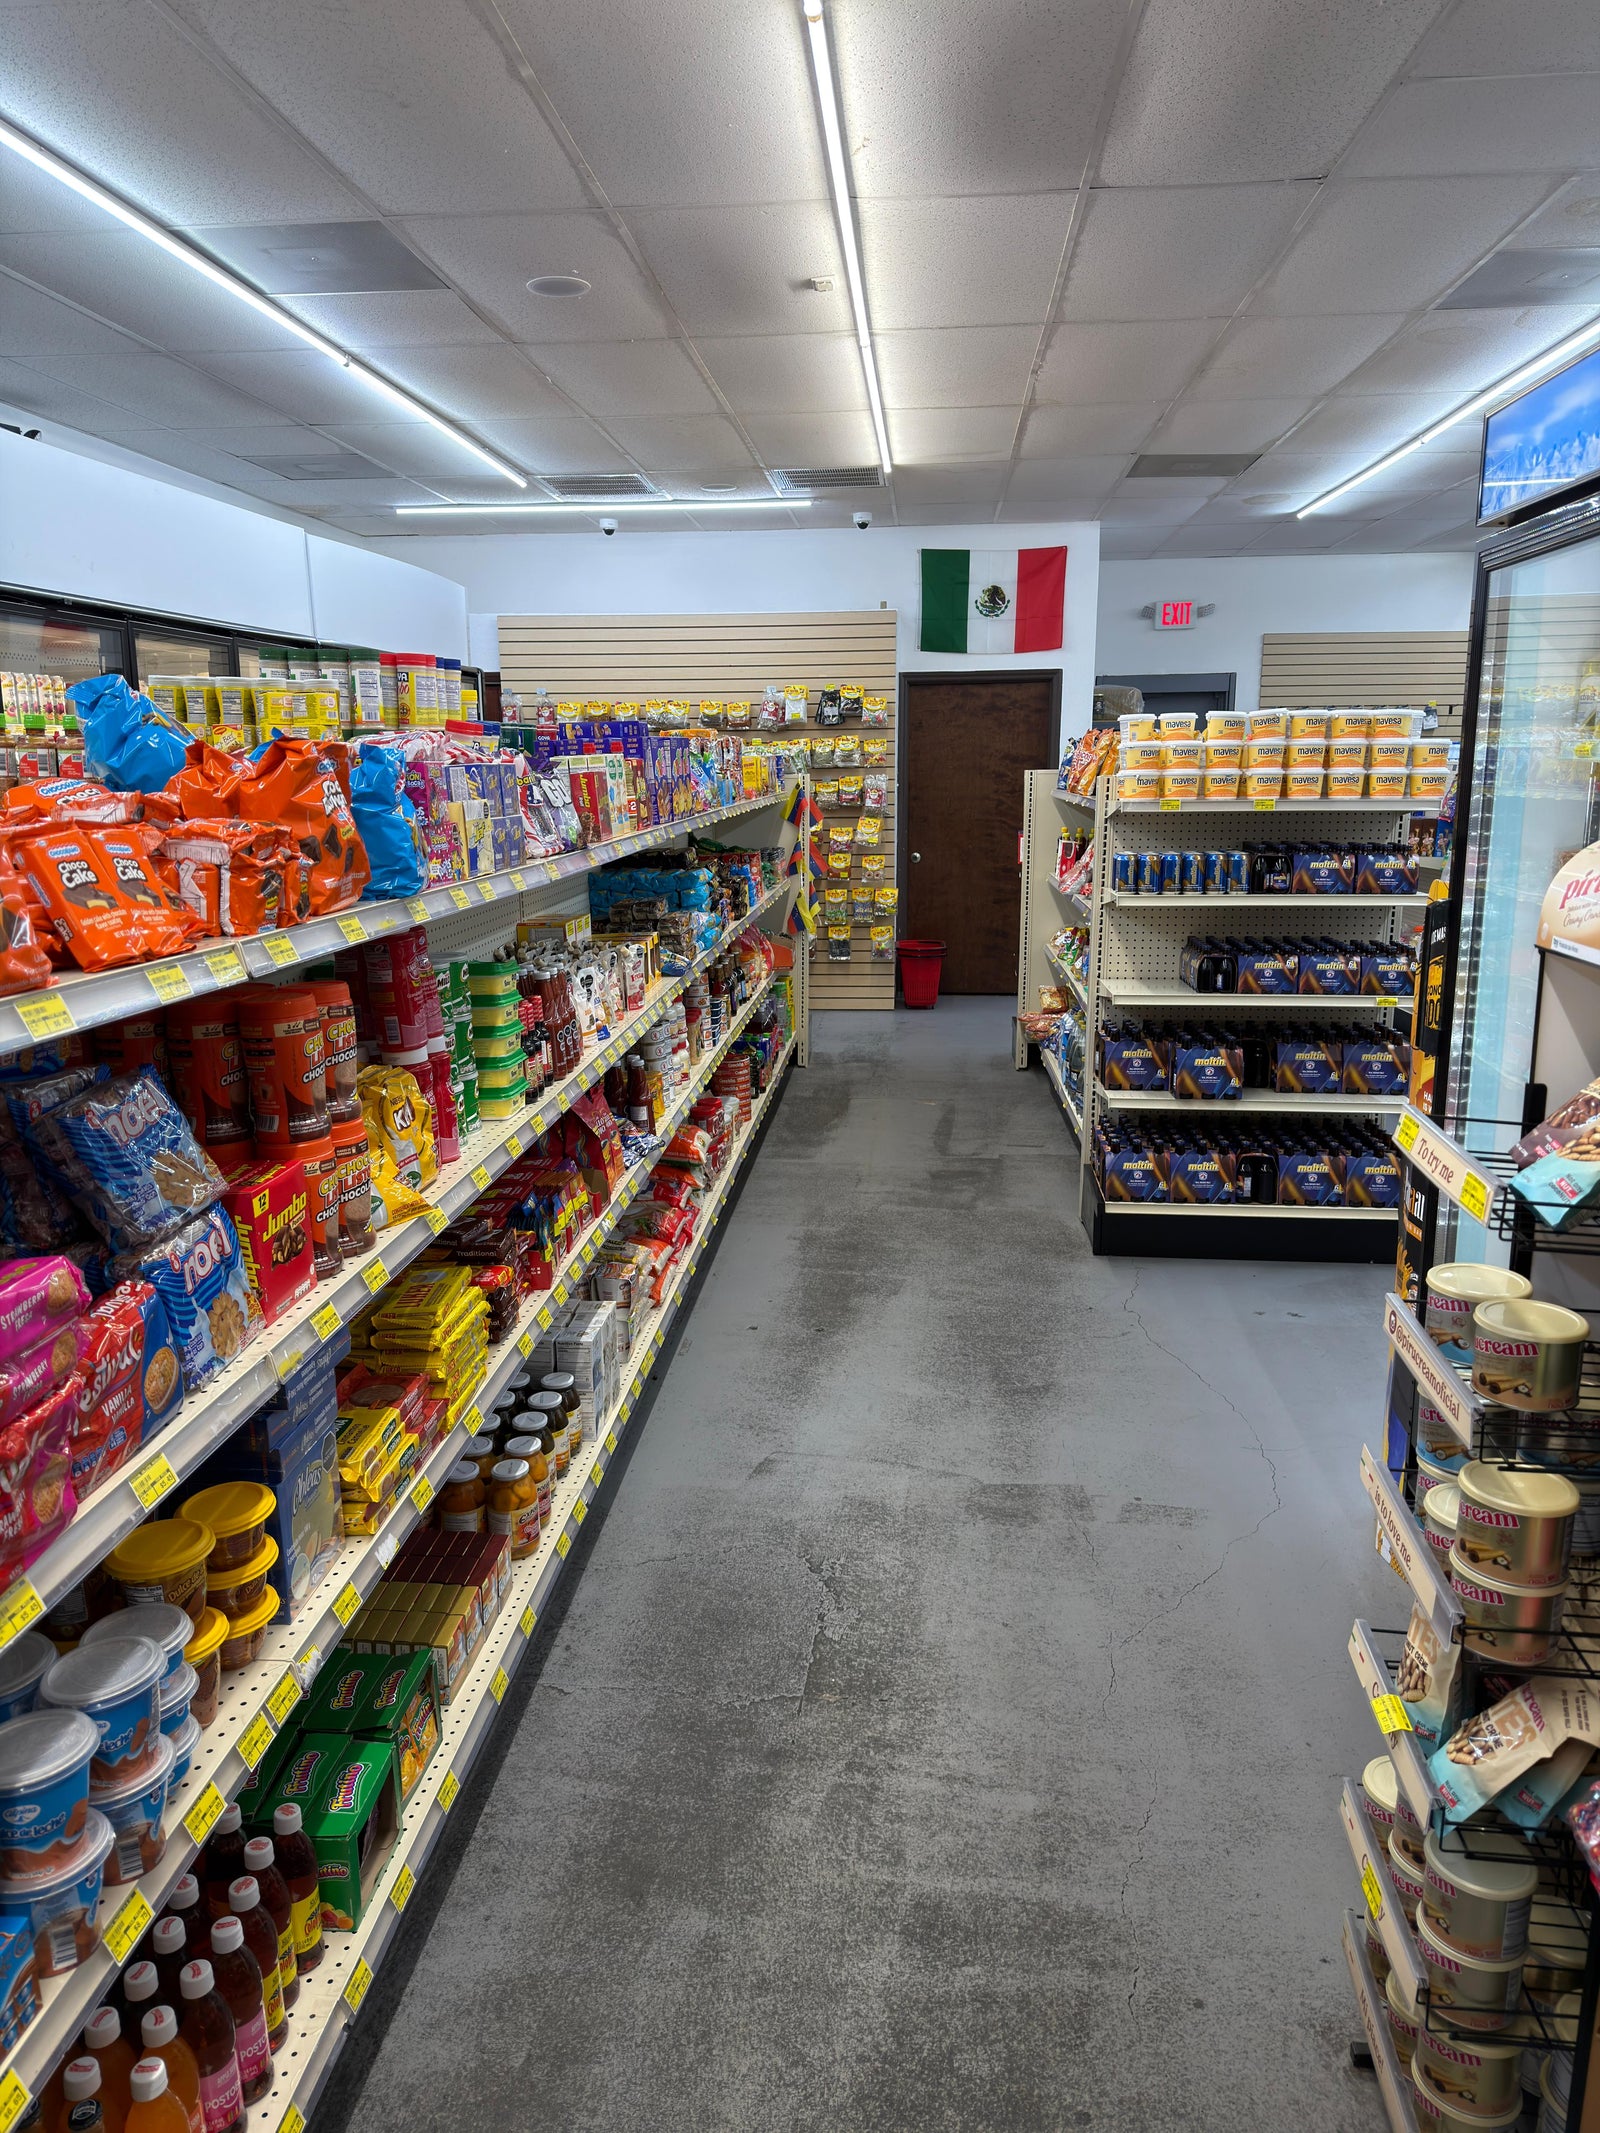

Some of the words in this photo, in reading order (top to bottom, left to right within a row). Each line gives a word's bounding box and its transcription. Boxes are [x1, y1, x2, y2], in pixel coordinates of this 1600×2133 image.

[1162, 602, 1192, 625] EXIT
[1165, 720, 1191, 728] mavesa
[1253, 717, 1280, 726] mavesa
[1172, 747, 1198, 756] mavesa
[1213, 748, 1239, 756] mavesa
[1335, 747, 1362, 755] mavesa
[1377, 747, 1405, 755] mavesa
[1172, 777, 1198, 785] mavesa
[1292, 776, 1319, 784] mavesa
[1332, 776, 1360, 784] mavesa
[579, 774, 591, 808] Jumbo
[58, 860, 87, 874] Choco
[113, 857, 138, 868] Choco
[62, 870, 98, 888] Cake
[117, 866, 146, 881] Cake
[102, 1075, 170, 1147] noel
[1416, 1138, 1428, 1159] To
[1427, 1148, 1441, 1174] try
[1439, 1161, 1454, 1184] me
[258, 1191, 267, 1208] 12
[263, 1191, 307, 1242] Jumbo
[183, 1217, 233, 1295] noel
[235, 1215, 260, 1291] Jumbo
[1, 1289, 45, 1330] STRAWBERRY
[12, 1358, 48, 1399] STRAWBERRY
[78, 1326, 142, 1412] estival
[1396, 1324, 1460, 1422] @pirucreamoficial
[1374, 1485, 1382, 1510] is
[1380, 1497, 1388, 1520] to
[1387, 1510, 1402, 1546] love
[1399, 1540, 1413, 1571] me.
[167, 1578, 192, 1602] Dulce
[1414, 1650, 1429, 1671] CRÈME
